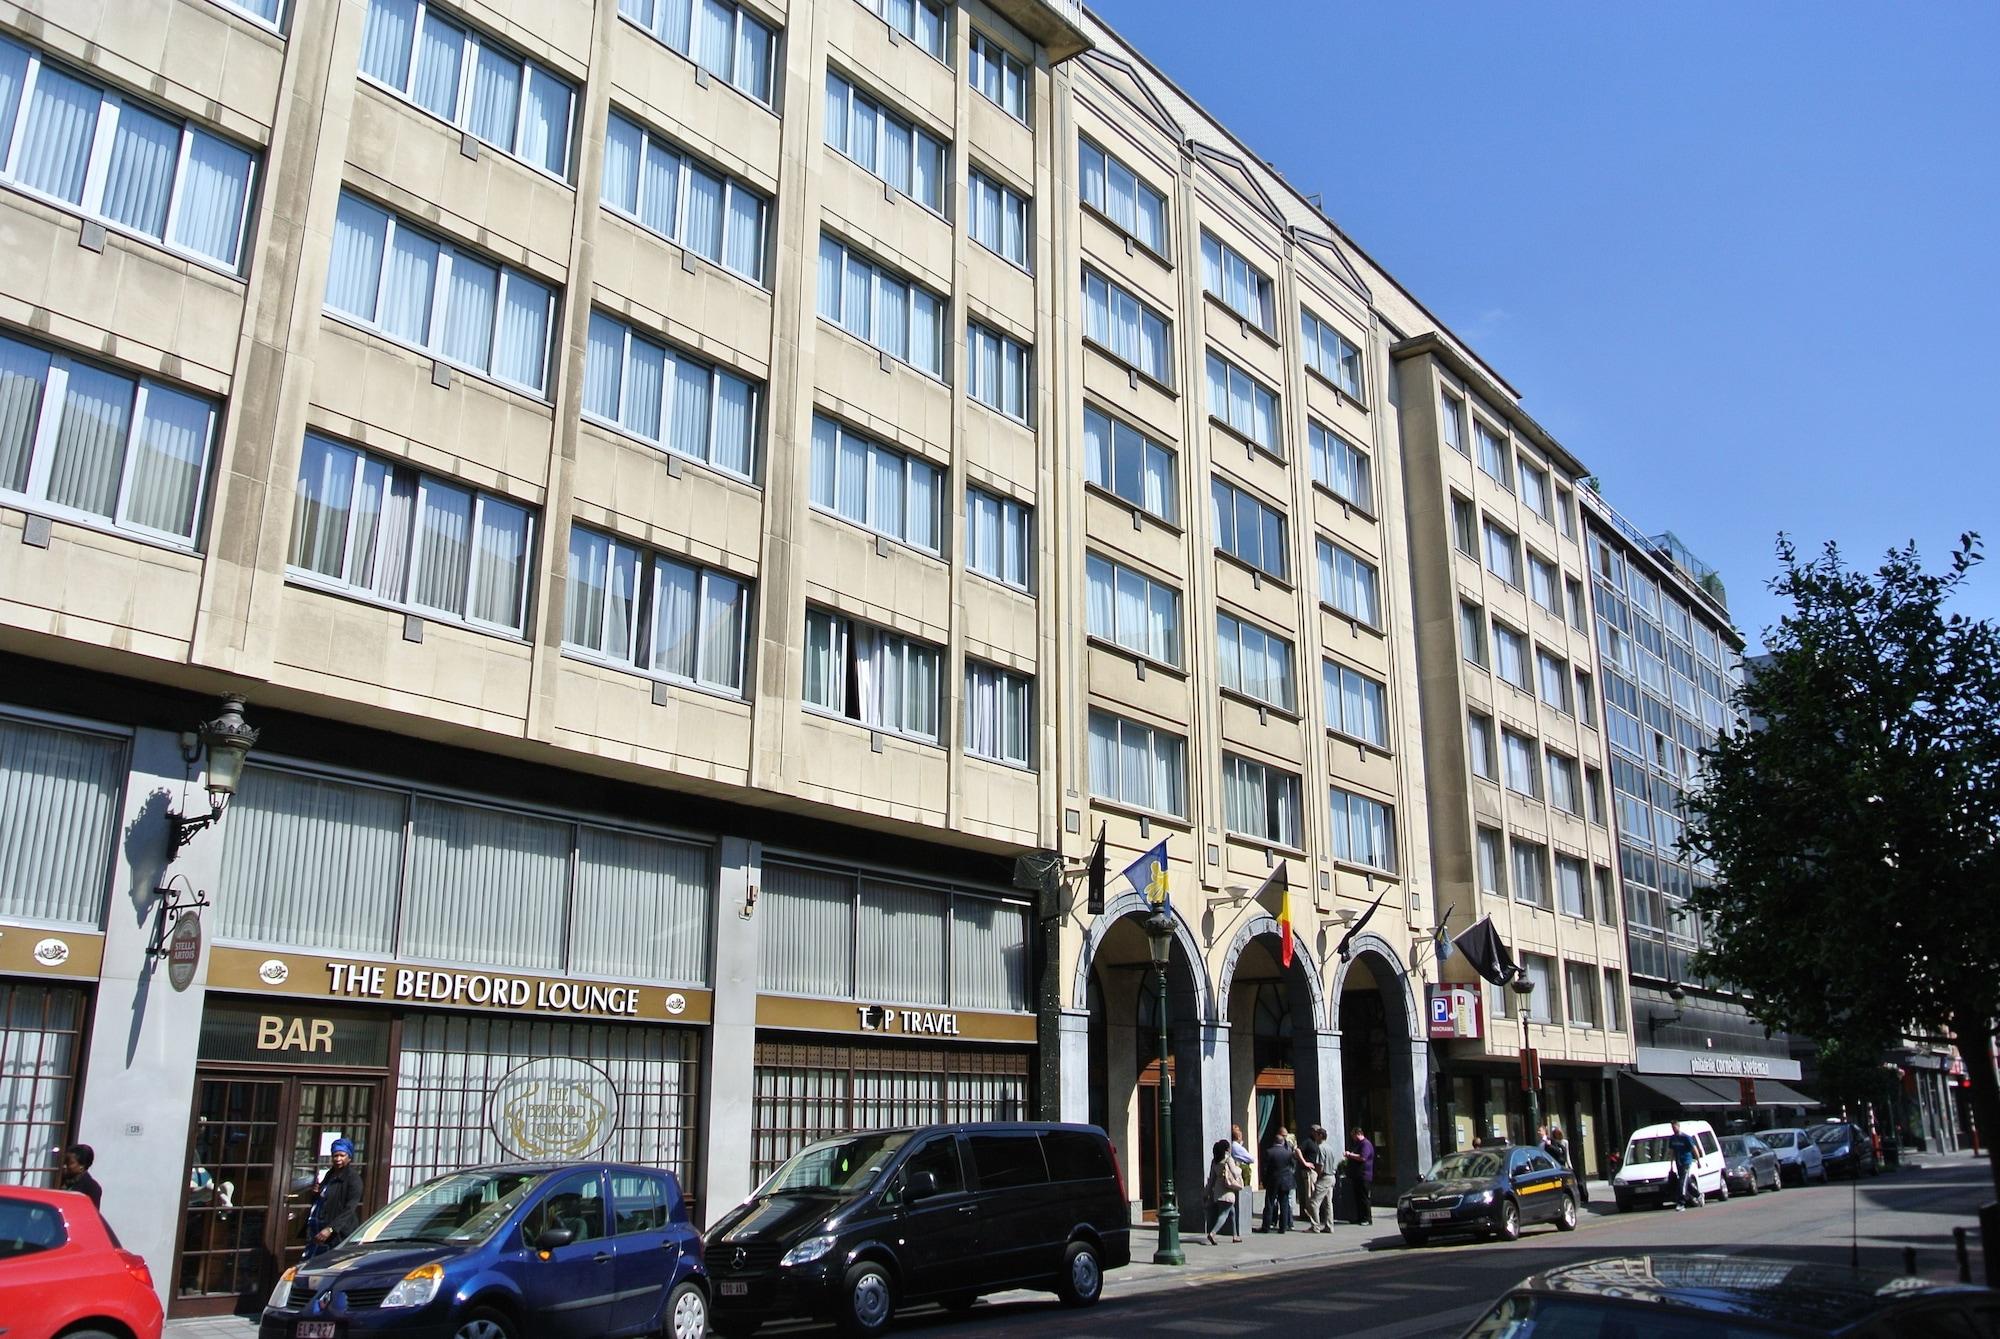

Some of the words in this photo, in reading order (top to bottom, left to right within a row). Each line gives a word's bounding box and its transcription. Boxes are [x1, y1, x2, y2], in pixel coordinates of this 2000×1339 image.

[175, 942, 195, 951] STELLA
[174, 951, 195, 960] ARTOIS
[327, 962, 387, 995] THE
[396, 968, 531, 1007] BEDFORD
[537, 981, 640, 1014] LOUNGE
[1433, 1001, 1445, 1020] P
[858, 1004, 895, 1030] TP
[900, 1010, 960, 1034] TRAVEL
[257, 1015, 335, 1053] BAR
[549, 1087, 569, 1102] THE
[528, 1104, 586, 1119] BEDFORD
[531, 1122, 579, 1138] LOUNGE
